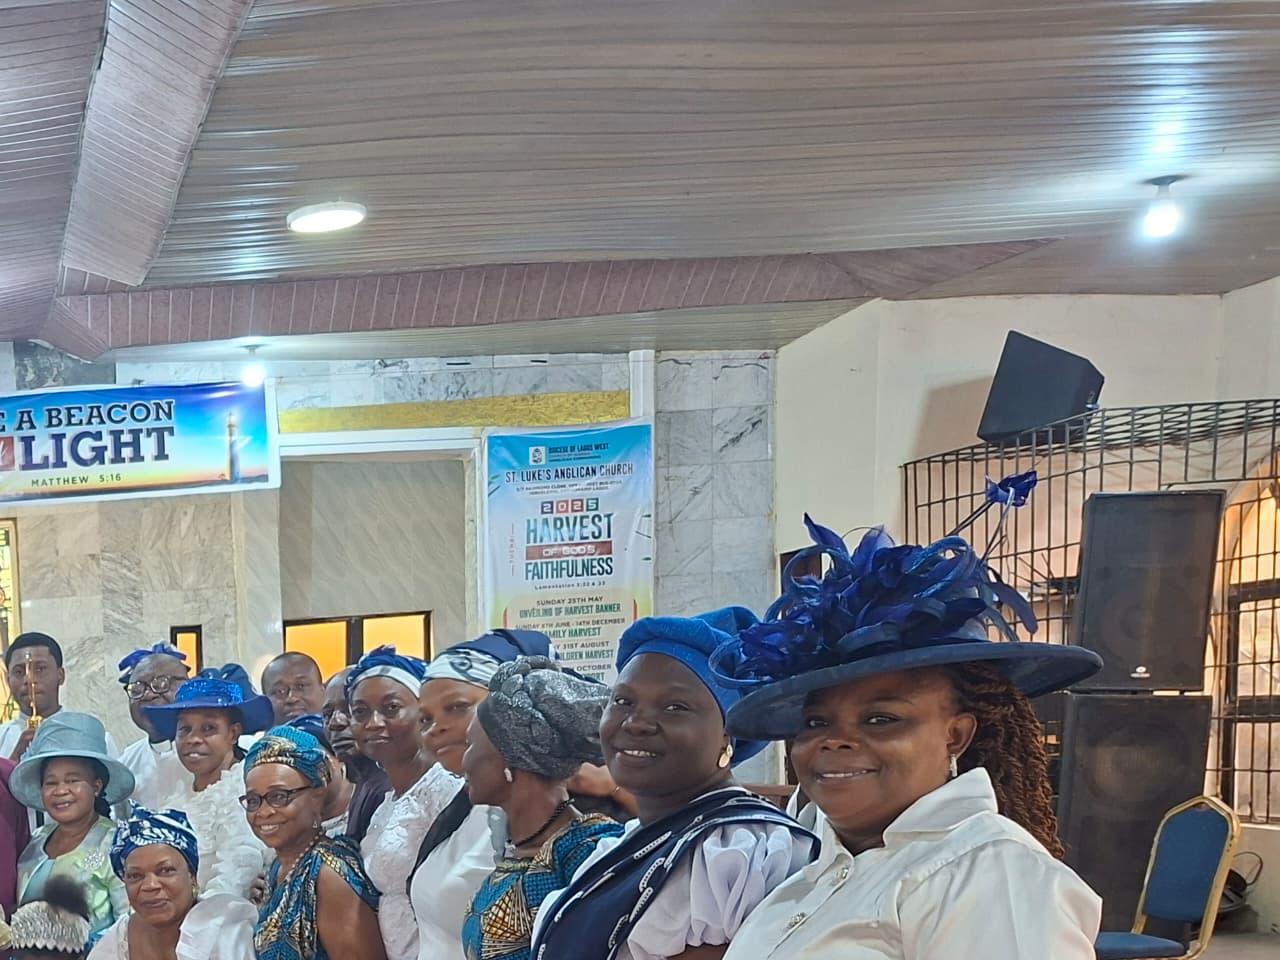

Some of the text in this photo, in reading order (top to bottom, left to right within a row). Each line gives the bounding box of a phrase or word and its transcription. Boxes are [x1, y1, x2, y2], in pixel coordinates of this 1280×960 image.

[15, 409, 37, 431] A
[45, 400, 175, 429] BEACON
[18, 426, 176, 471] LIGHT
[31, 473, 122, 487] MATTHEW 5:16
[505, 463, 633, 483] ST. LUKE'S ANGLICAN CHURCH
[542, 499, 597, 513] 2025
[526, 512, 614, 545] HARVEST
[542, 548, 560, 557] OF
[524, 557, 614, 581] FAITHFULNESS
[564, 604, 594, 616] HARVEST
[595, 602, 622, 614] BANNER
[554, 621, 570, 629] JUNE
[591, 618, 626, 626] DECEMBER
[568, 626, 602, 638] HARVEST
[580, 640, 610, 649] AUGUST
[585, 649, 614, 660] HARVEST
[576, 663, 612, 672] OCTOBER
